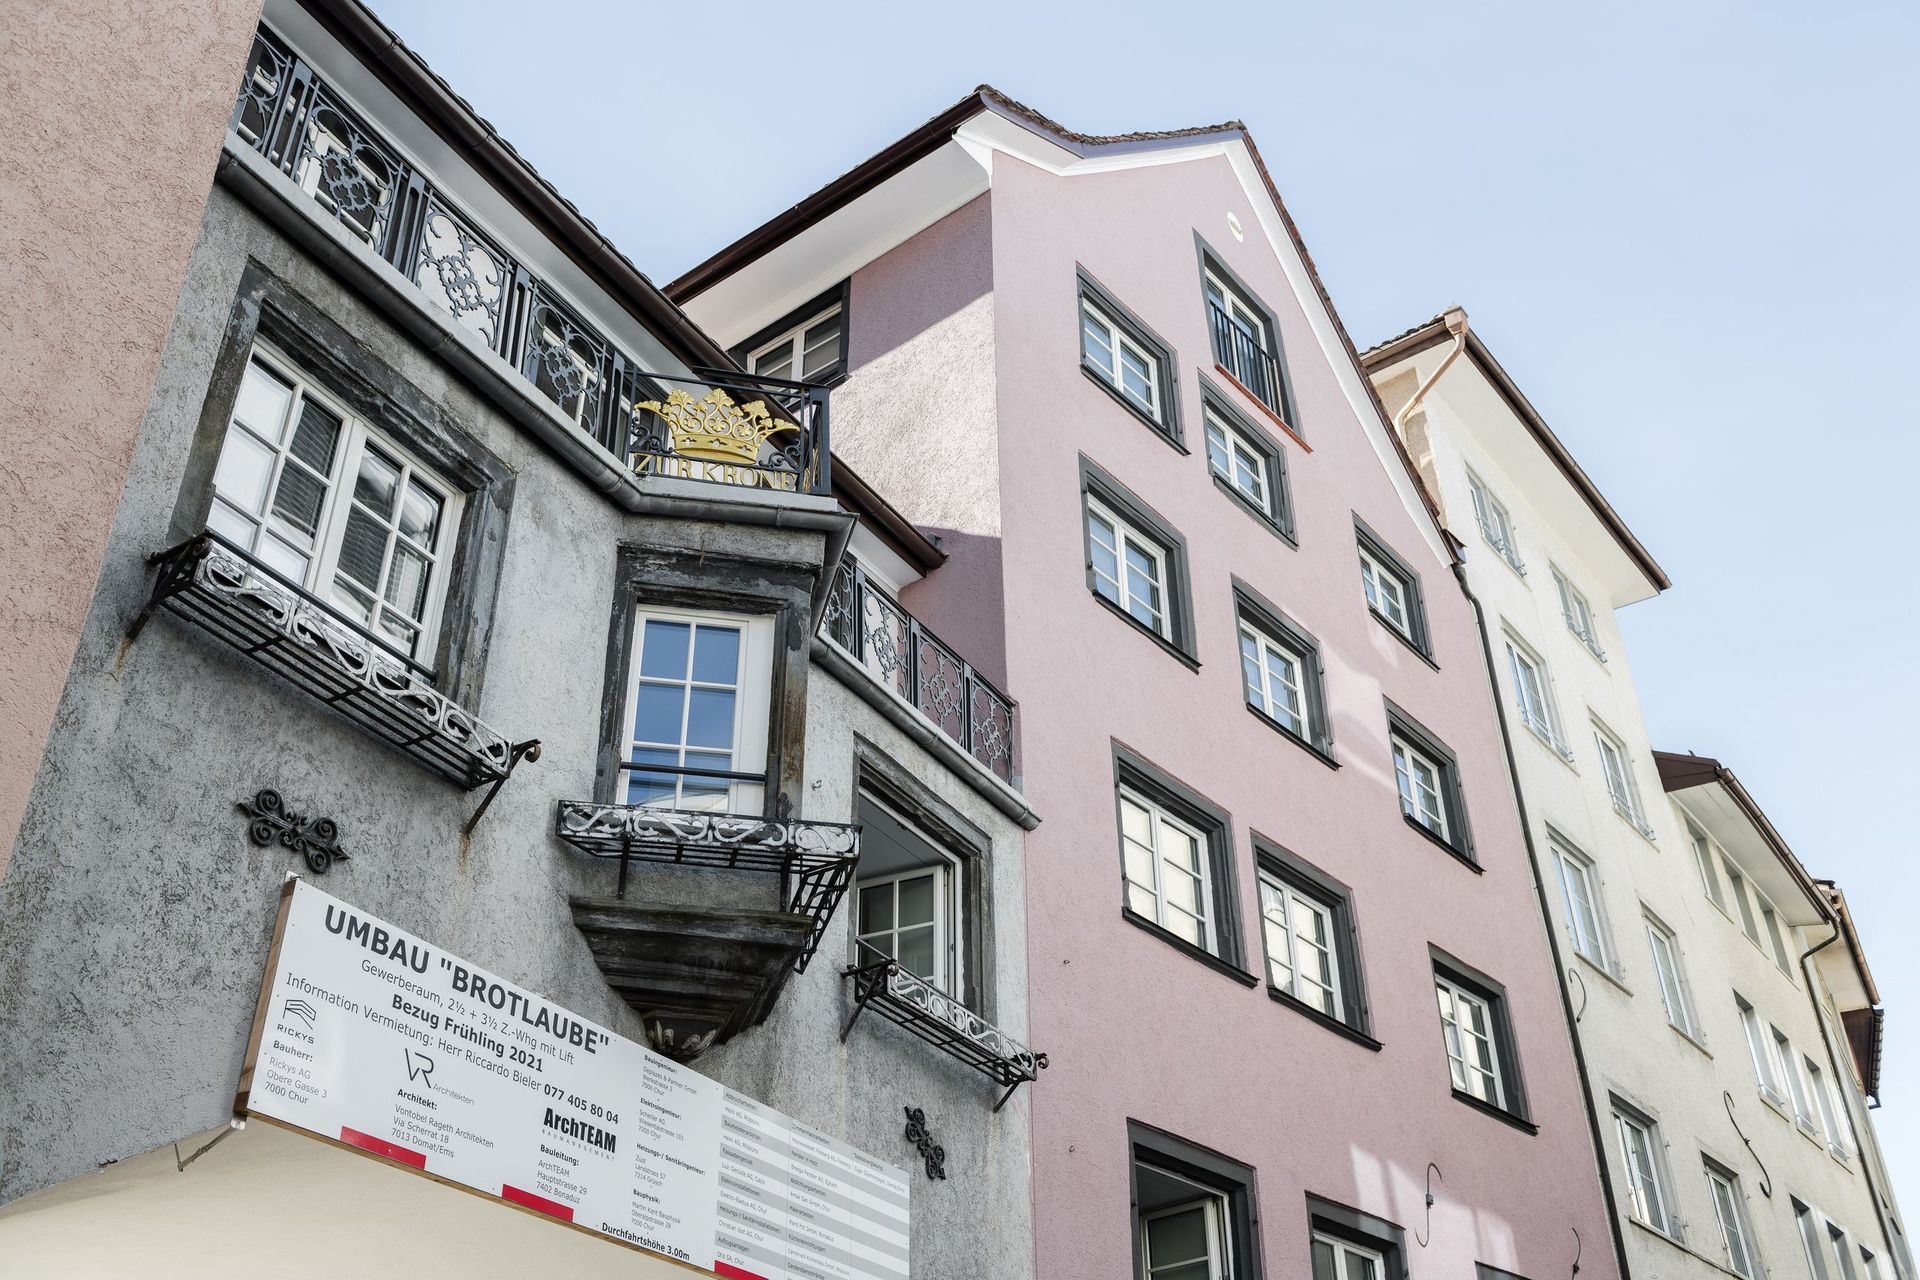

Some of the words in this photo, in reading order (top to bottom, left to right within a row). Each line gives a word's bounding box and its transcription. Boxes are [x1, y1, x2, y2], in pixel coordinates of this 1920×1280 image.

[633, 452, 693, 479] ZUR
[702, 464, 798, 492] KRONE
[325, 904, 429, 974] UMBAU
[441, 957, 609, 1054] "BROTLAUBE"
[362, 959, 443, 1008] Gewerberaum,
[448, 998, 465, 1016] 2½
[469, 1010, 477, 1019] +
[481, 1013, 497, 1030] 3½
[501, 1022, 537, 1050] Z.-Whg
[540, 1042, 557, 1057] mit
[559, 1049, 574, 1065] Lift
[277, 1023, 314, 1044] RICKYS
[392, 994, 439, 1029] Bezug
[444, 1017, 504, 1058] Frühling
[509, 1046, 542, 1072] 2021
[273, 1040, 313, 1062] Bauherr:
[286, 972, 359, 1014] Information
[364, 1005, 433, 1046] Vermietung:
[438, 1037, 463, 1057] Herr
[465, 1049, 509, 1078] Riccardo
[513, 1070, 542, 1091] Bieler
[544, 1084, 564, 1100] 077
[567, 1095, 587, 1111] 405
[590, 1104, 603, 1118] 80
[606, 1110, 619, 1125] 04
[269, 1056, 296, 1074] Rickys
[298, 1068, 311, 1079] AG
[644, 1054, 677, 1074] Bauingenieur:
[265, 1081, 286, 1096] 7000
[288, 1090, 309, 1104] Chur
[267, 1069, 292, 1086] Obere
[294, 1080, 319, 1096] Gasse
[321, 1089, 327, 1099] 3
[433, 1083, 474, 1105] Architekten
[654, 1087, 665, 1096] Chur
[397, 1089, 437, 1110] Architekt:
[640, 1097, 681, 1120] Elektroingenieur:
[393, 1116, 405, 1127] Via
[407, 1121, 438, 1140] Scherrat
[440, 1134, 449, 1144] 18
[395, 1104, 427, 1123] Vontobel
[429, 1117, 454, 1133] Rageth
[455, 1127, 494, 1149] Architekten
[543, 1107, 616, 1153] ArchTEAM
[650, 1130, 661, 1139] Chur
[391, 1127, 410, 1142] 7013
[412, 1135, 454, 1158] Domat/Ems
[540, 1144, 579, 1166] Bauleitung:
[538, 1159, 570, 1177] ArchTEAM
[536, 1181, 552, 1194] 7402
[554, 1187, 580, 1204] Bonaduz
[537, 1170, 578, 1192] Hauptstrasse
[579, 1186, 587, 1195] 29
[633, 1188, 660, 1204] Bauphysik:
[602, 1222, 665, 1252] Durchfahrtshöhe
[667, 1245, 689, 1261] 3.00m
